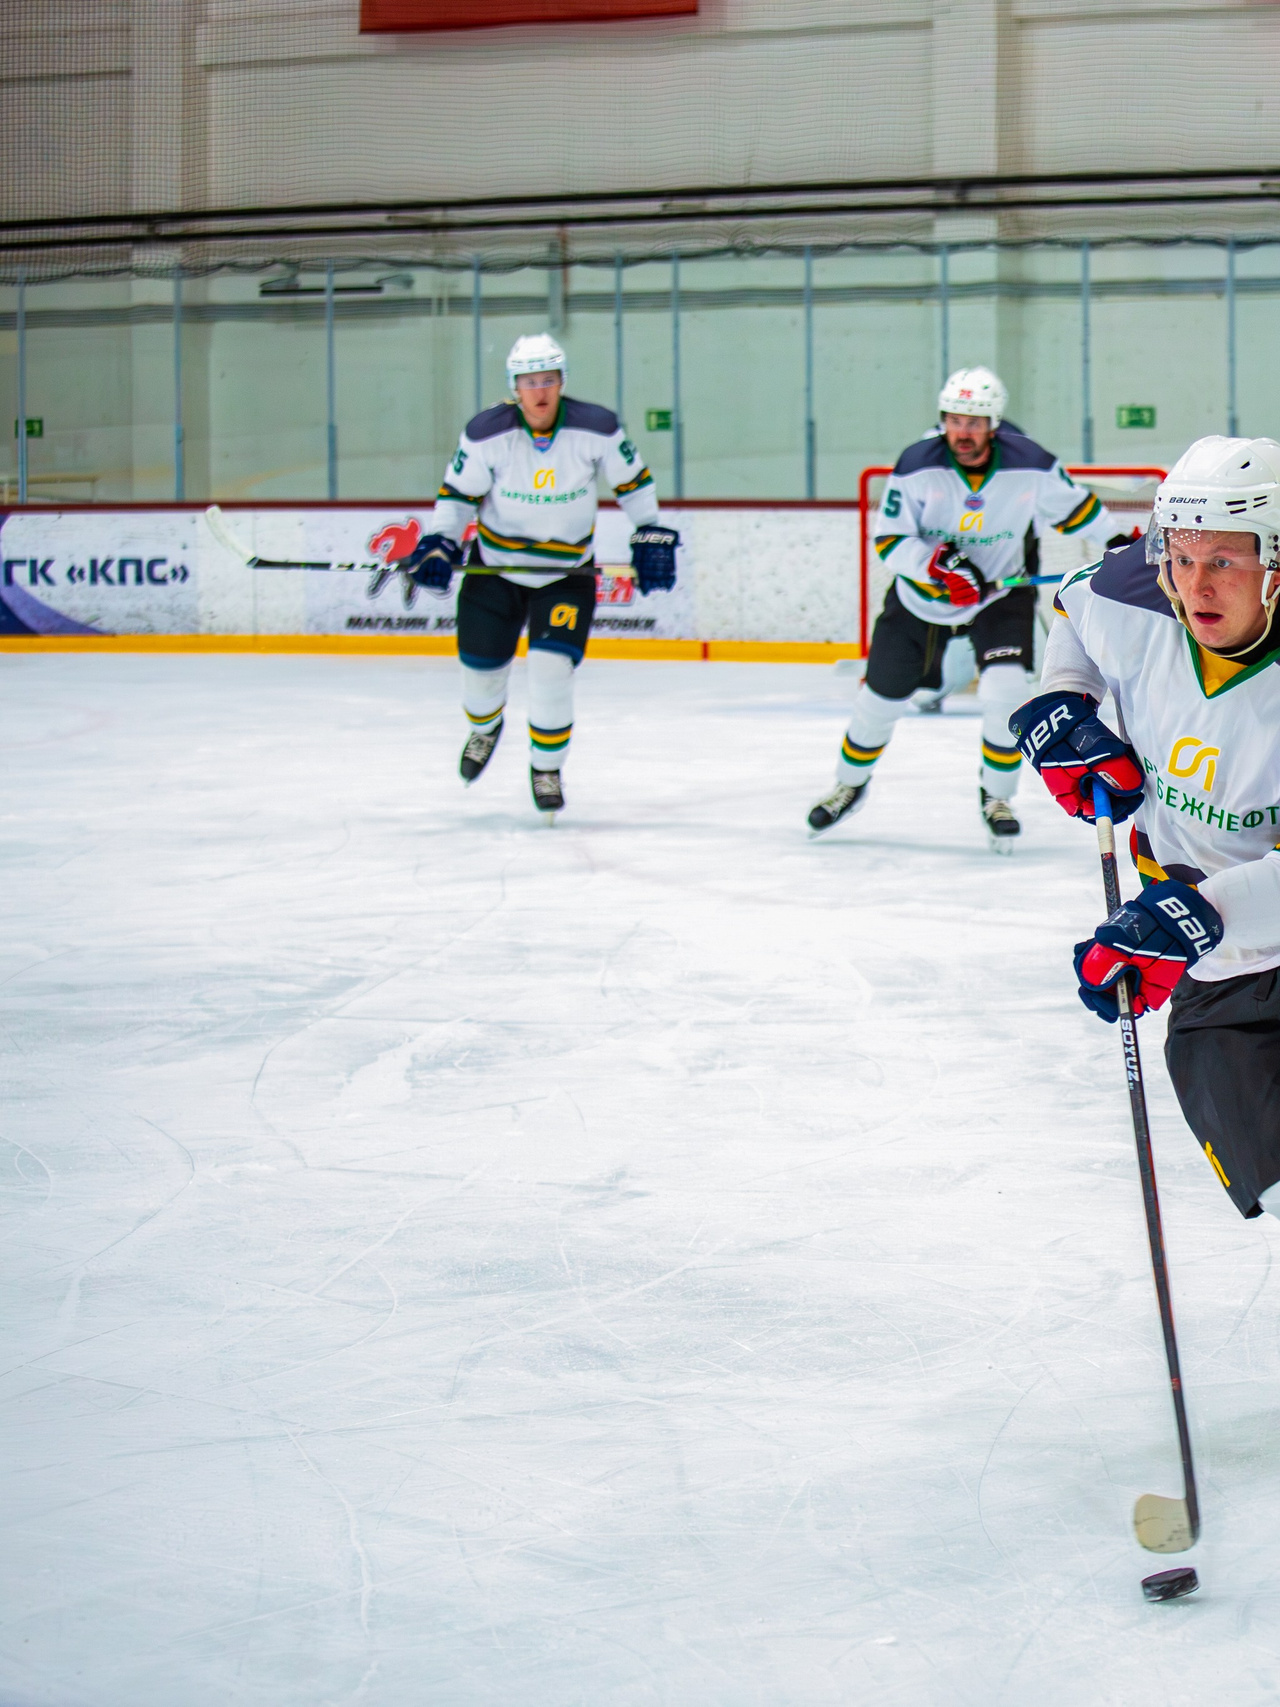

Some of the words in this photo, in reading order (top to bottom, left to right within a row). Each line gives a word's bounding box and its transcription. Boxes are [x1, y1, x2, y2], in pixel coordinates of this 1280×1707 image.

[453, 449, 469, 475] 5
[631, 533, 675, 545] AUER
[4, 559, 55, 586] ГК
[67, 559, 189, 586] «КПС»
[1021, 704, 1074, 764] UER
[1156, 896, 1213, 957] BAU
[1121, 1019, 1140, 1082] SOYUZ
